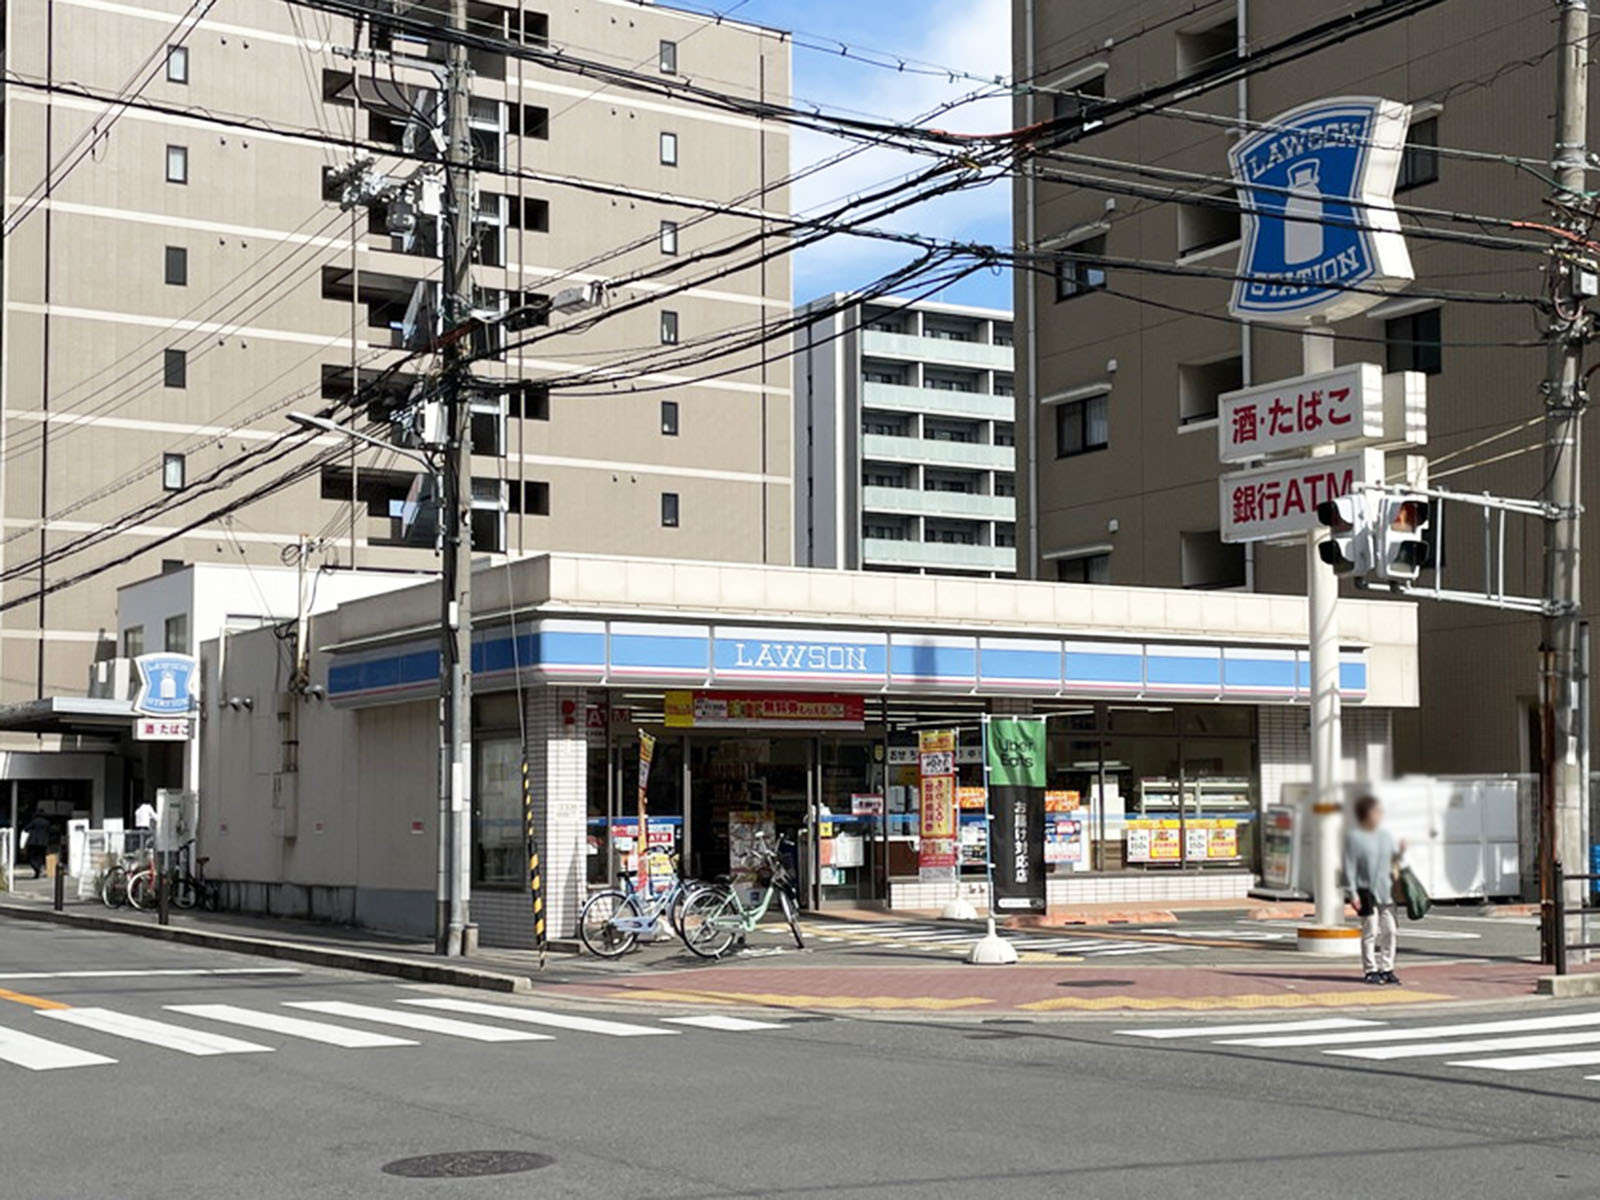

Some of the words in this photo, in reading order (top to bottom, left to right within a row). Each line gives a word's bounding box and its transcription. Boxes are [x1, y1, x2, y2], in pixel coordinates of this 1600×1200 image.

[1249, 121, 1362, 179] LAWSON
[1250, 246, 1360, 296] STATION
[735, 643, 867, 670] LAWSON
[998, 738, 1035, 752] Uber
[1000, 752, 1034, 768] Eats
